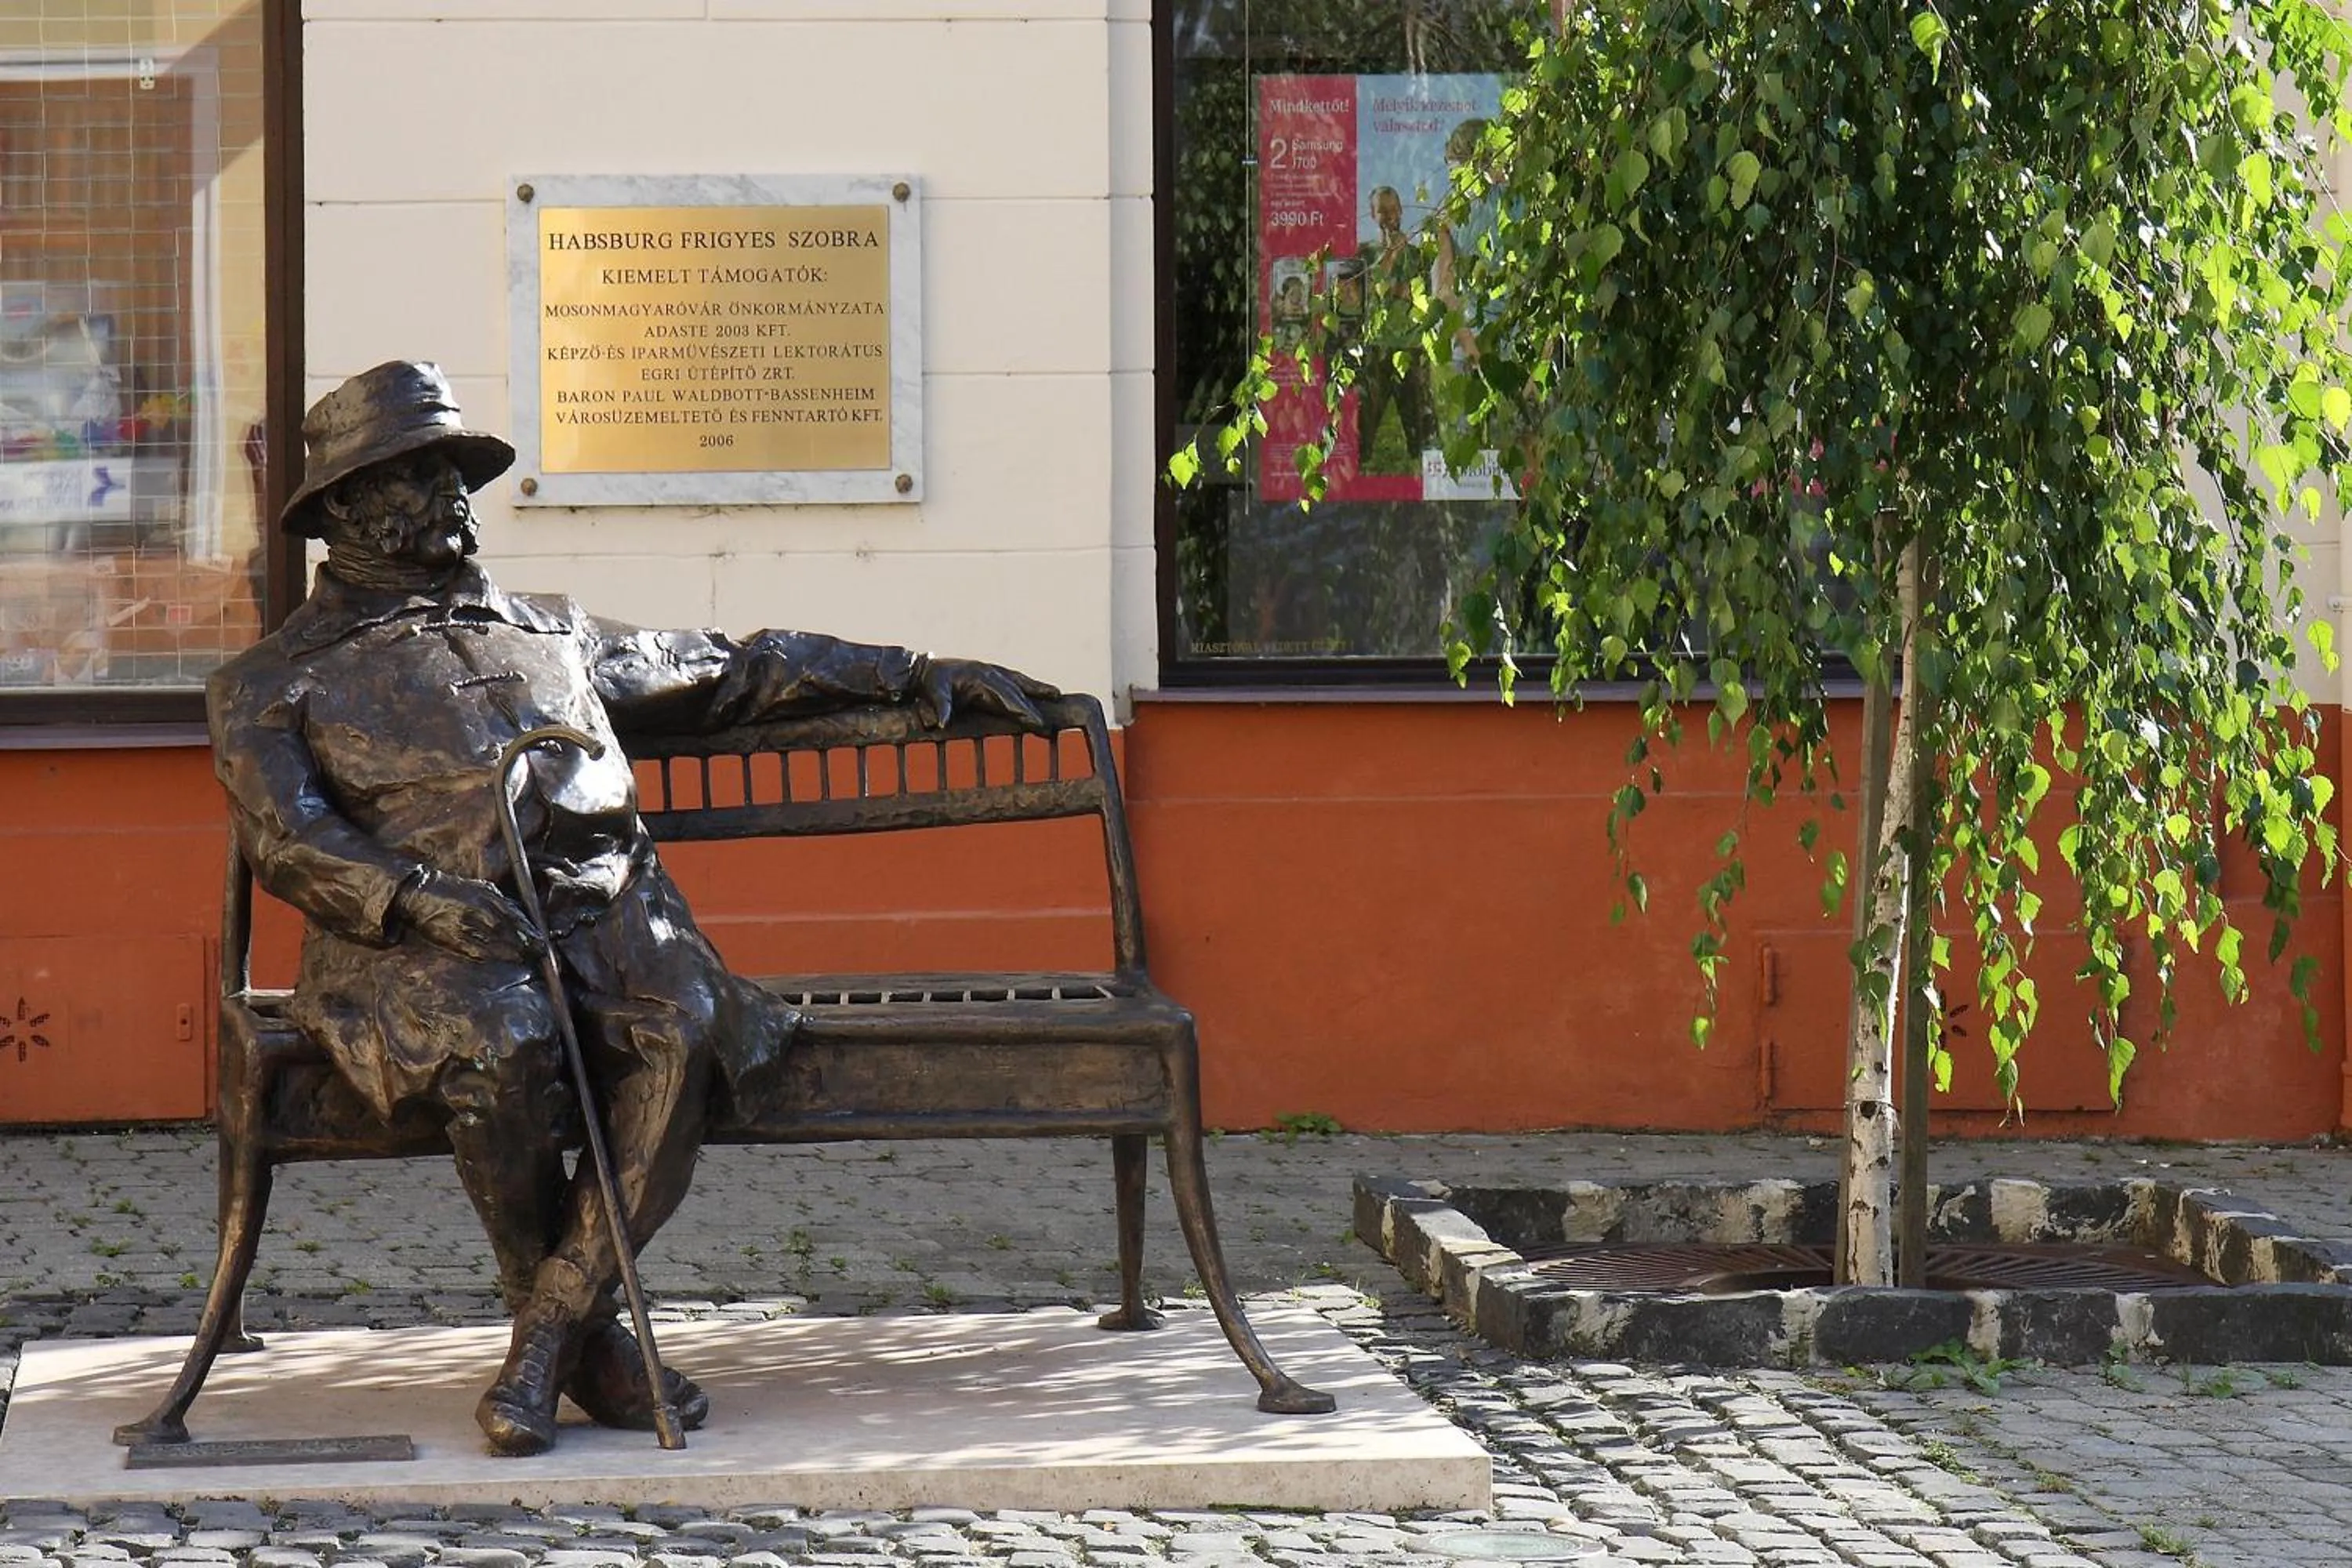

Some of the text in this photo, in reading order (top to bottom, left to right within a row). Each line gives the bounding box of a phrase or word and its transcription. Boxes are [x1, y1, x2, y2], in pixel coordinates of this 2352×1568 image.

[1269, 138, 1344, 169] 2 Samsung
[1270, 210, 1324, 227] 3990 Ft
[549, 230, 879, 250] HABSBURG FRIGYES SZOBRA
[602, 264, 828, 285] KIEMELT TÁMOGATÓK:
[546, 299, 884, 318] MOSONMAGYARÓVÁR ÖNKORMÁNYZATA
[644, 324, 791, 338] ADASTE 2003 KFT.
[773, 343, 883, 358] LEKTORÁTUS
[641, 368, 681, 381] EGRI
[763, 367, 795, 380] ZRT.
[557, 390, 615, 403] BARON
[622, 390, 666, 403] PAUL
[730, 407, 747, 423] ÉS
[752, 406, 848, 423] FENNTARTÓ
[852, 409, 884, 423] KFT.
[699, 435, 734, 448] 2006
